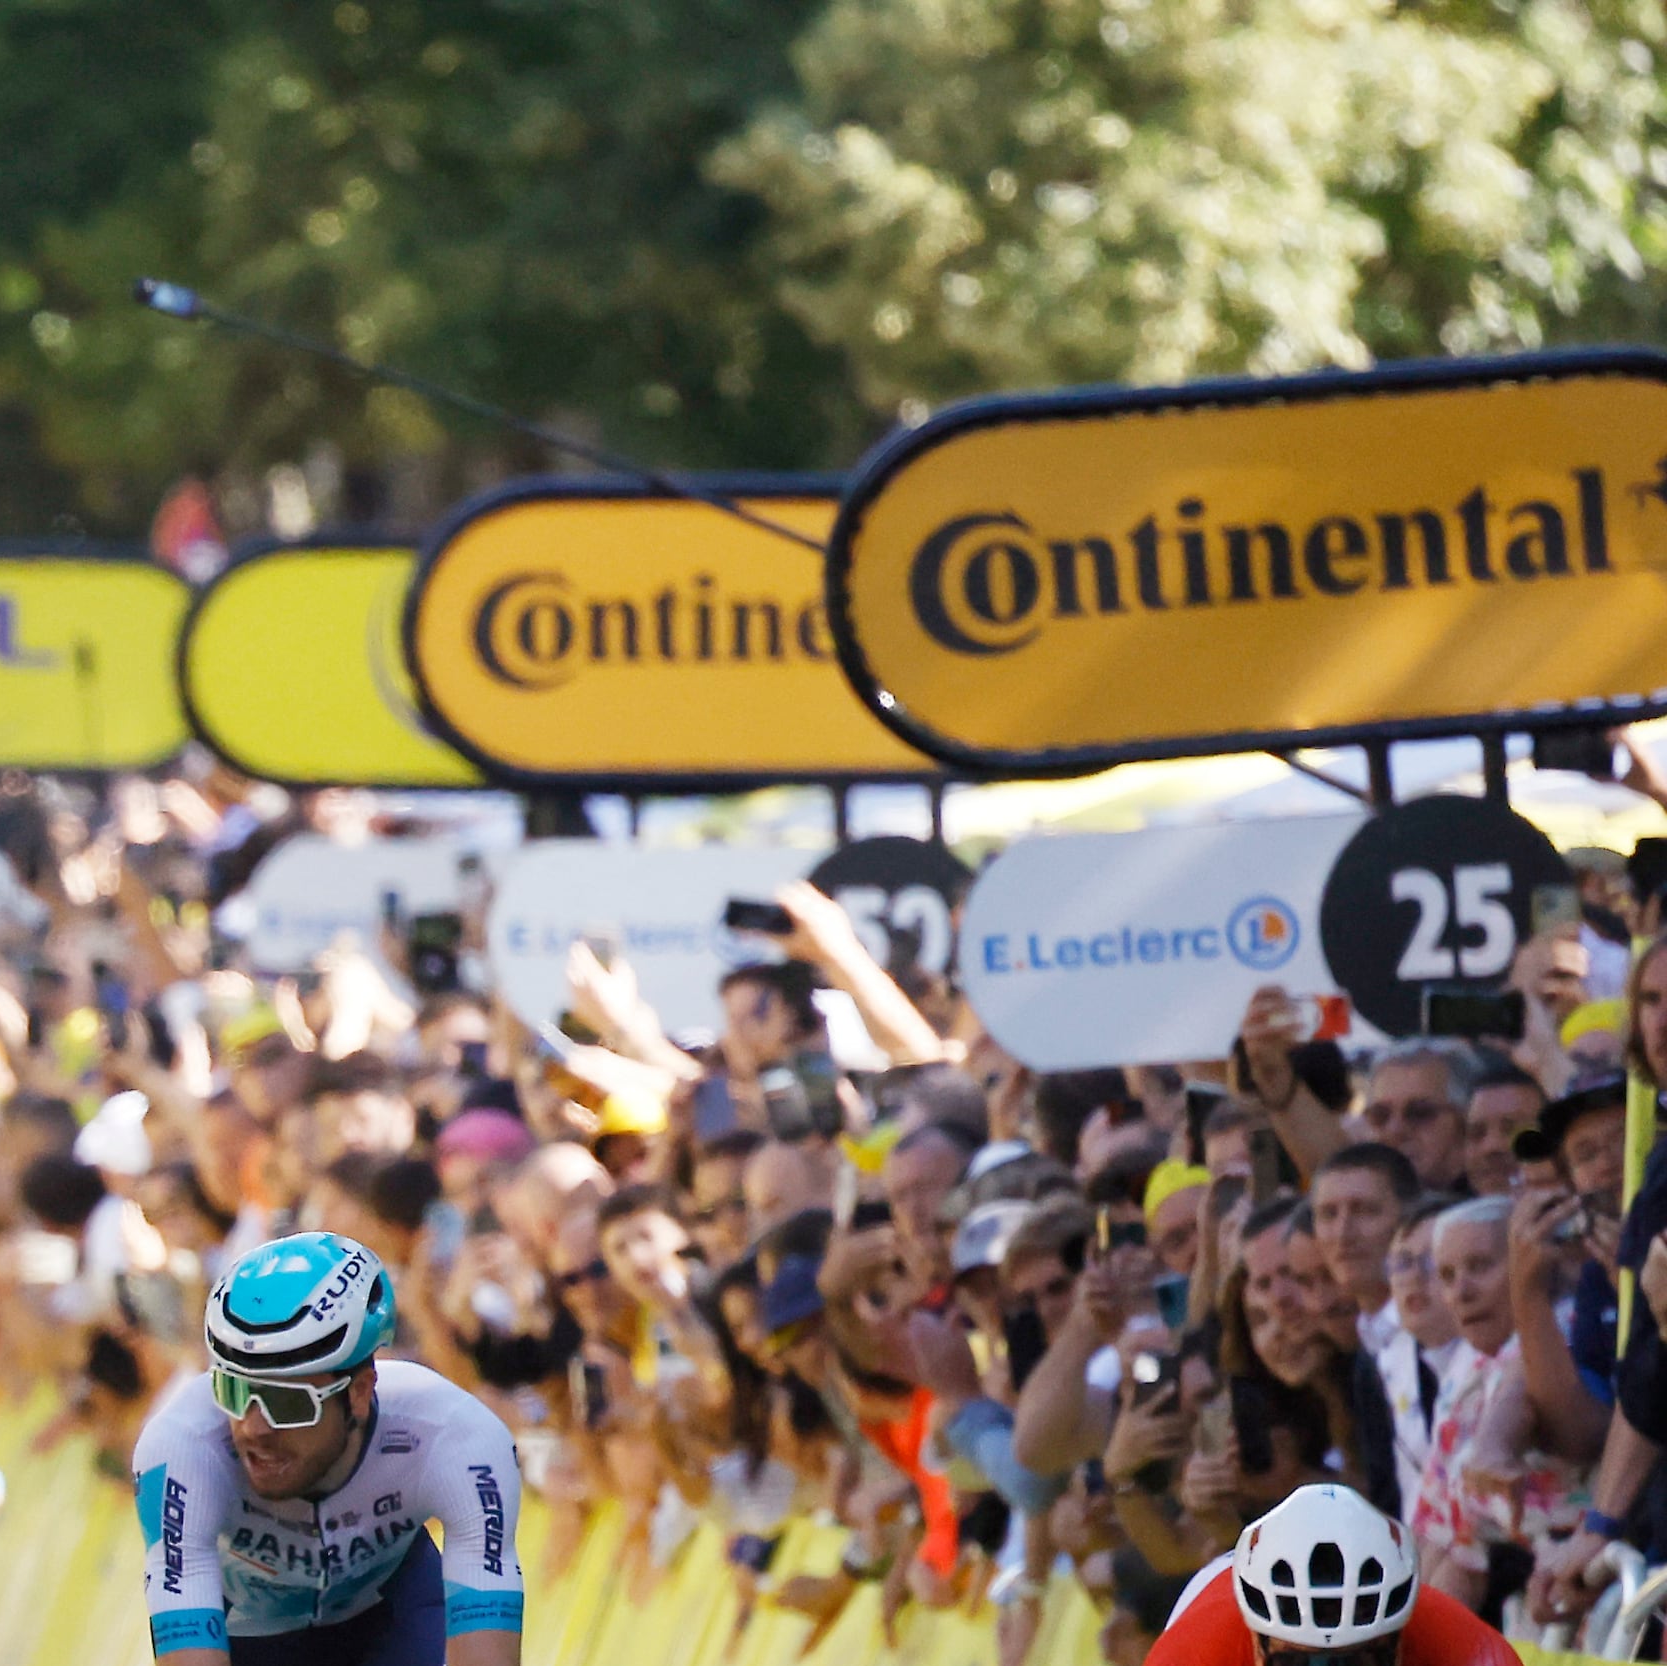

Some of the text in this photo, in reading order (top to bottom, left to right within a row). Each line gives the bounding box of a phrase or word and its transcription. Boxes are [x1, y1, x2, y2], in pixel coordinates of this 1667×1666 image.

[909, 466, 1613, 656] Continental
[982, 925, 1223, 976] E.Leclerc
[1390, 862, 1515, 980] 25
[310, 1250, 369, 1322] RUDY
[163, 1476, 189, 1595] MERIDA
[233, 1516, 417, 1569] BAHRAIN
[468, 1464, 505, 1577] MERIDA
